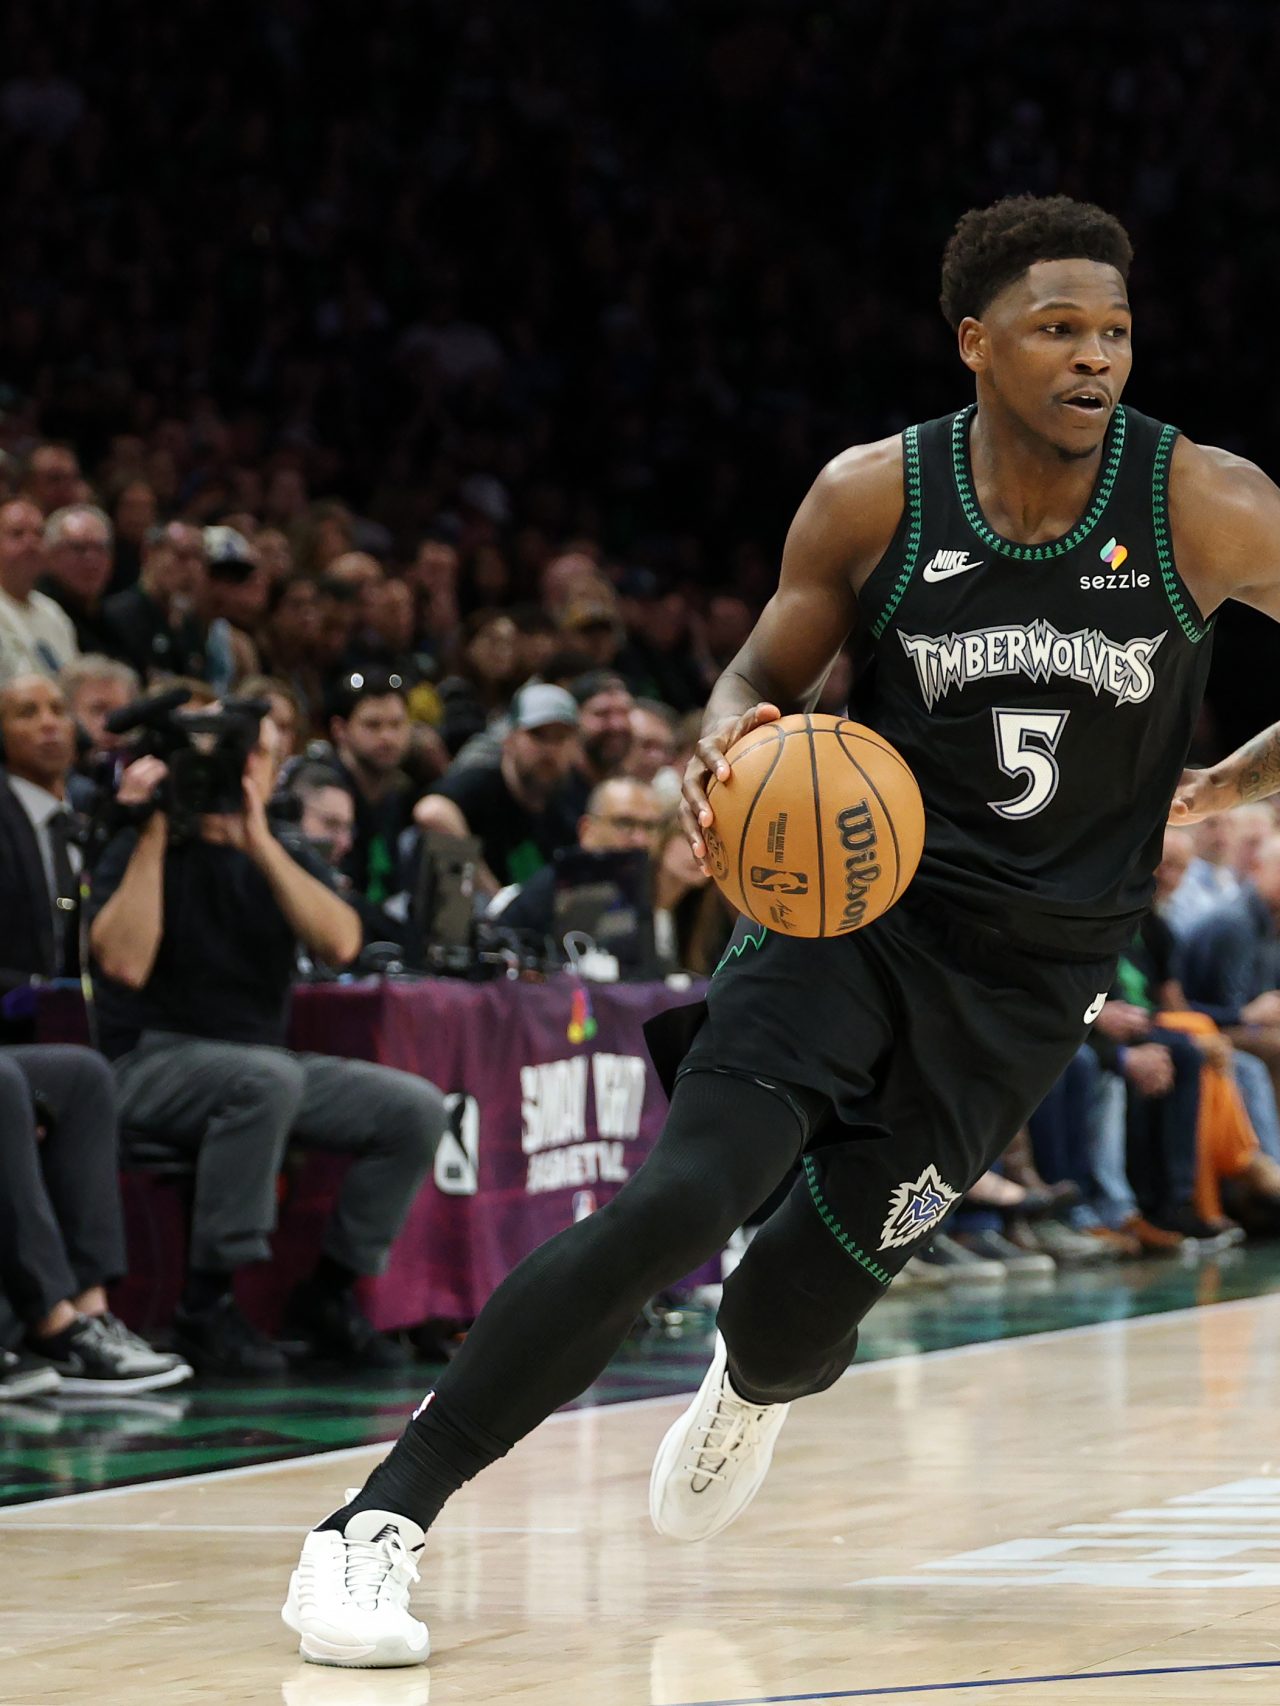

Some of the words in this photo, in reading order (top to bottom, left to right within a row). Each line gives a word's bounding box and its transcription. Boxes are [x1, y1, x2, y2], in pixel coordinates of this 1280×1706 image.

[931, 549, 970, 570] NIKE
[1079, 569, 1151, 590] sezzle
[896, 618, 1168, 713] TIMBERWOLVES
[987, 707, 1070, 820] 5
[835, 798, 881, 931] Wilson
